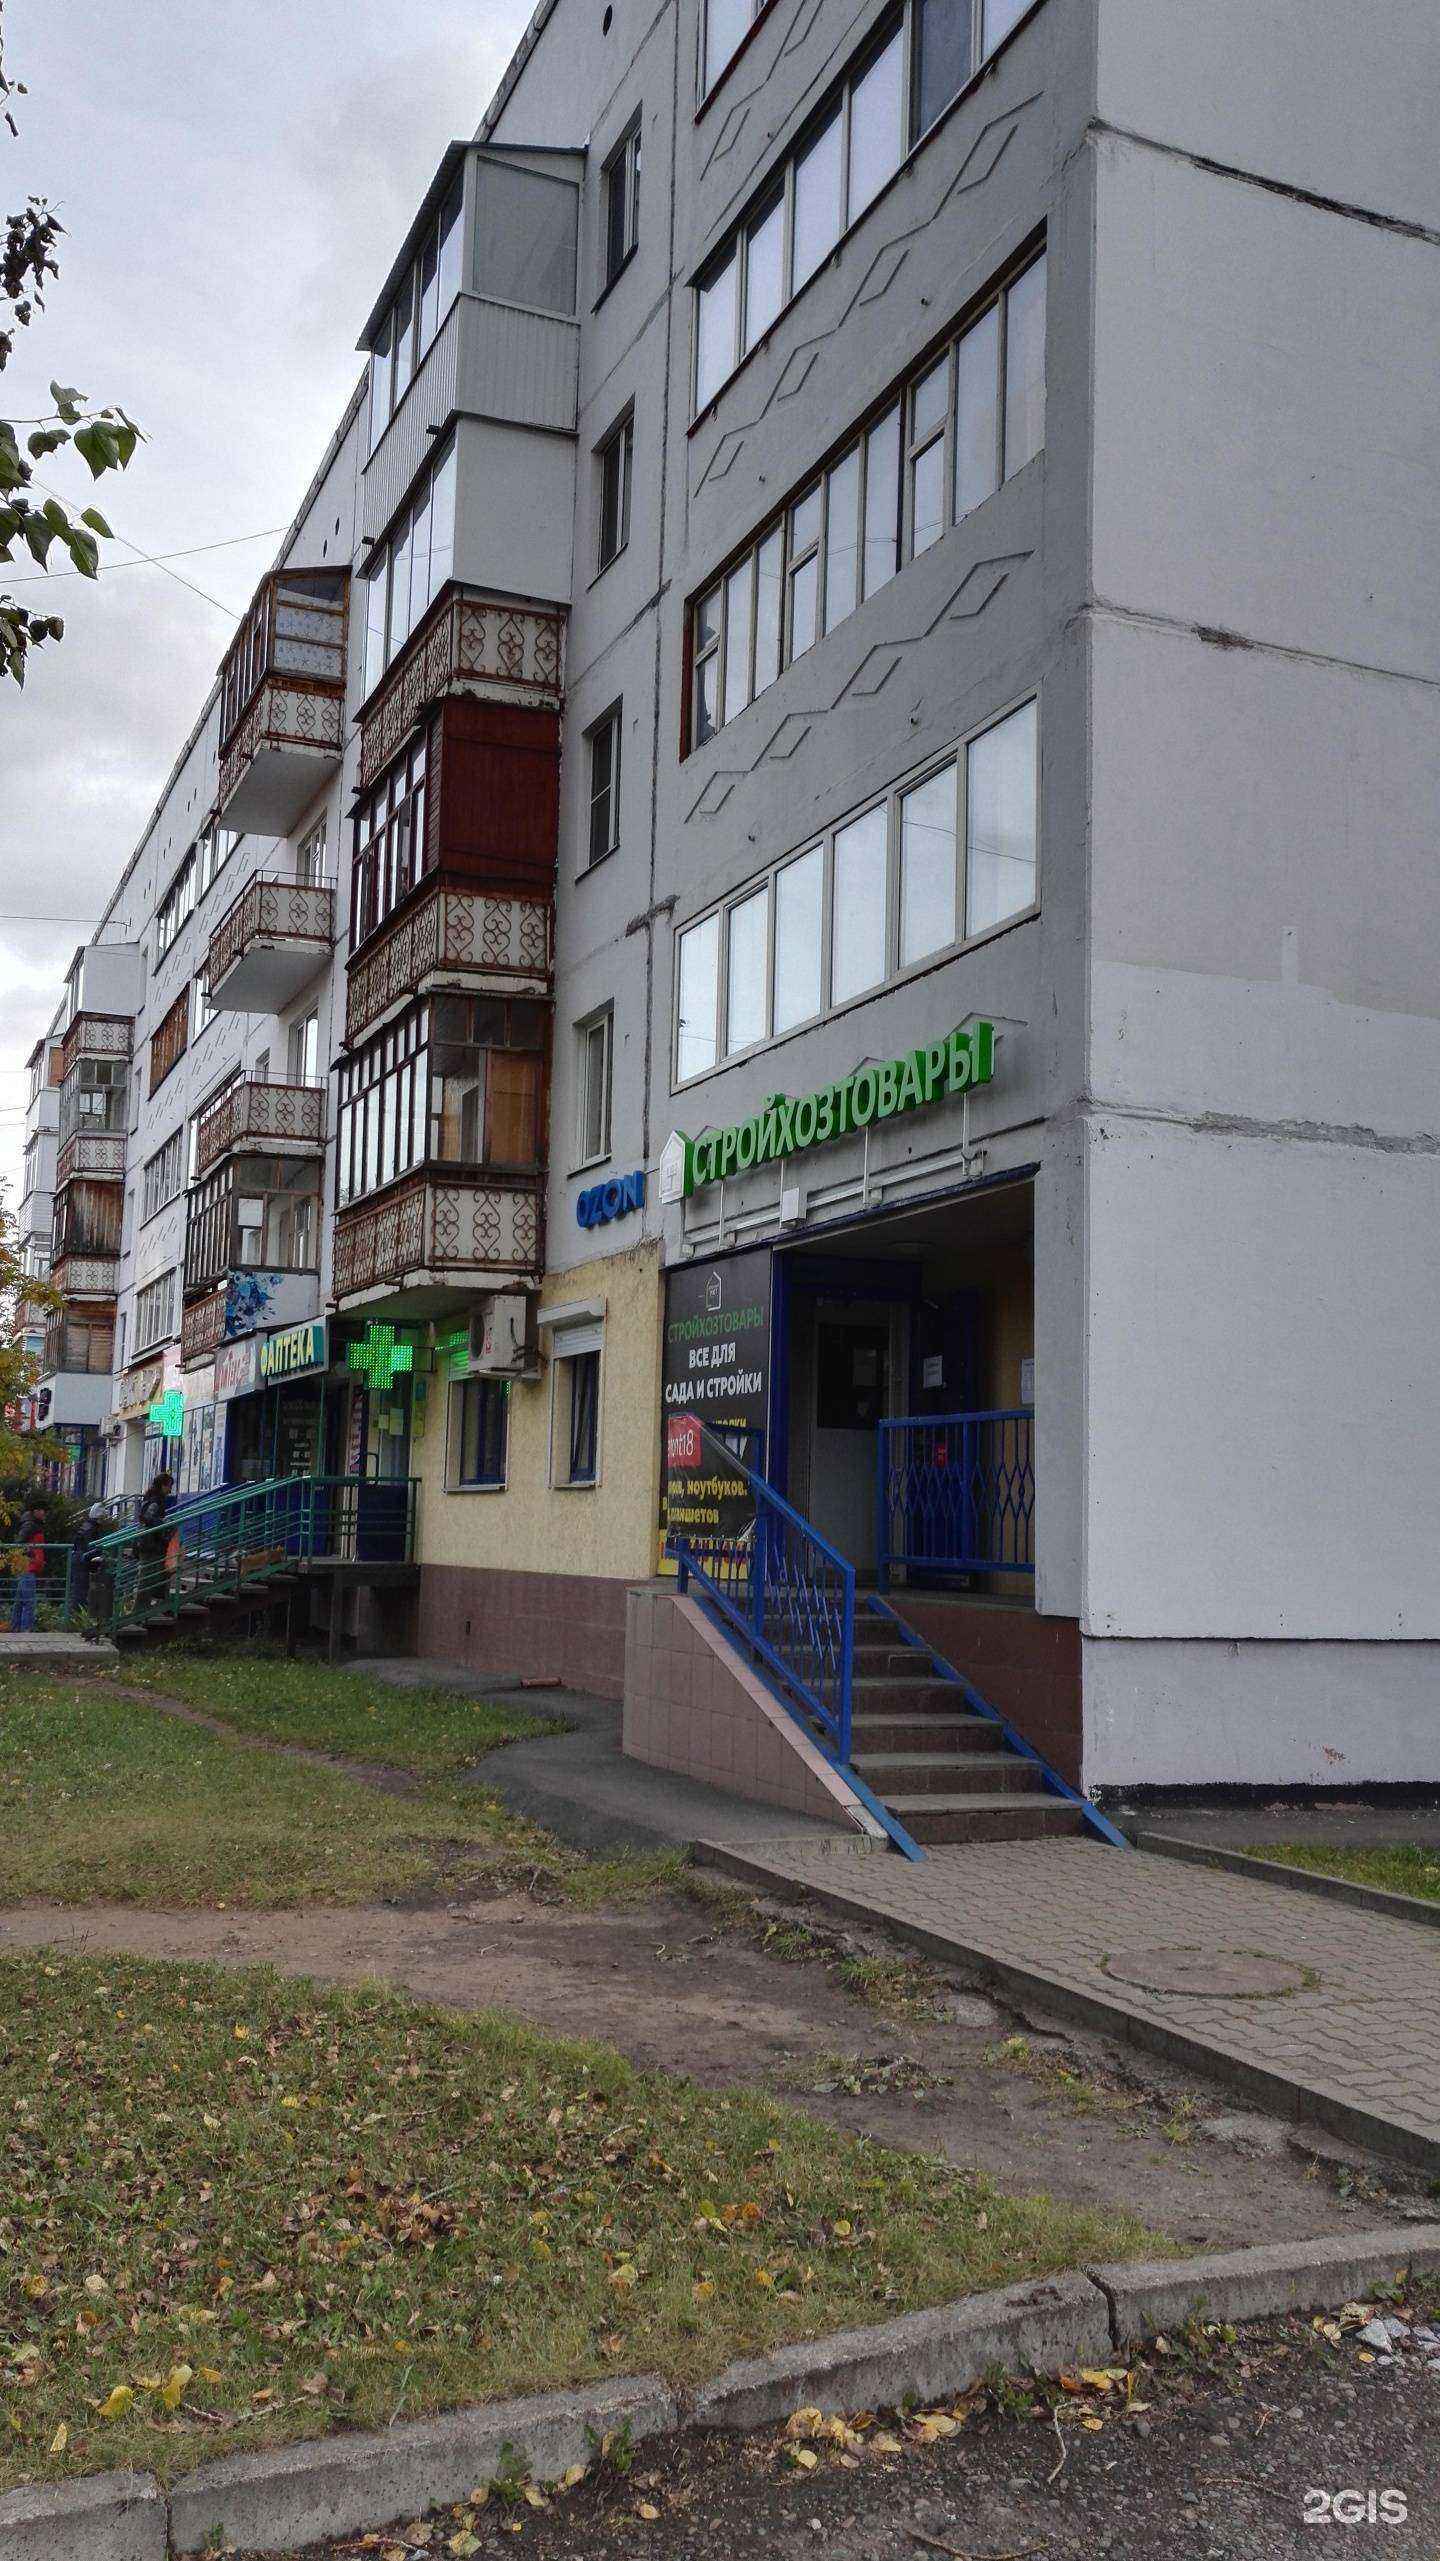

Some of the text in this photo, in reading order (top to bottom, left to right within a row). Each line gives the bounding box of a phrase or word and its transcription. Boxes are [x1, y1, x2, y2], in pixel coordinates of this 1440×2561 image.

[692, 1021, 996, 1186] СТРОЙХОЗТОВАРЫ
[667, 1306, 764, 1343] СТРОЙХОЗТОВАРЫ
[688, 1342, 736, 1368] ВСЕ ДЛЯ
[665, 1369, 762, 1405] САДА И СТРОЙКИ
